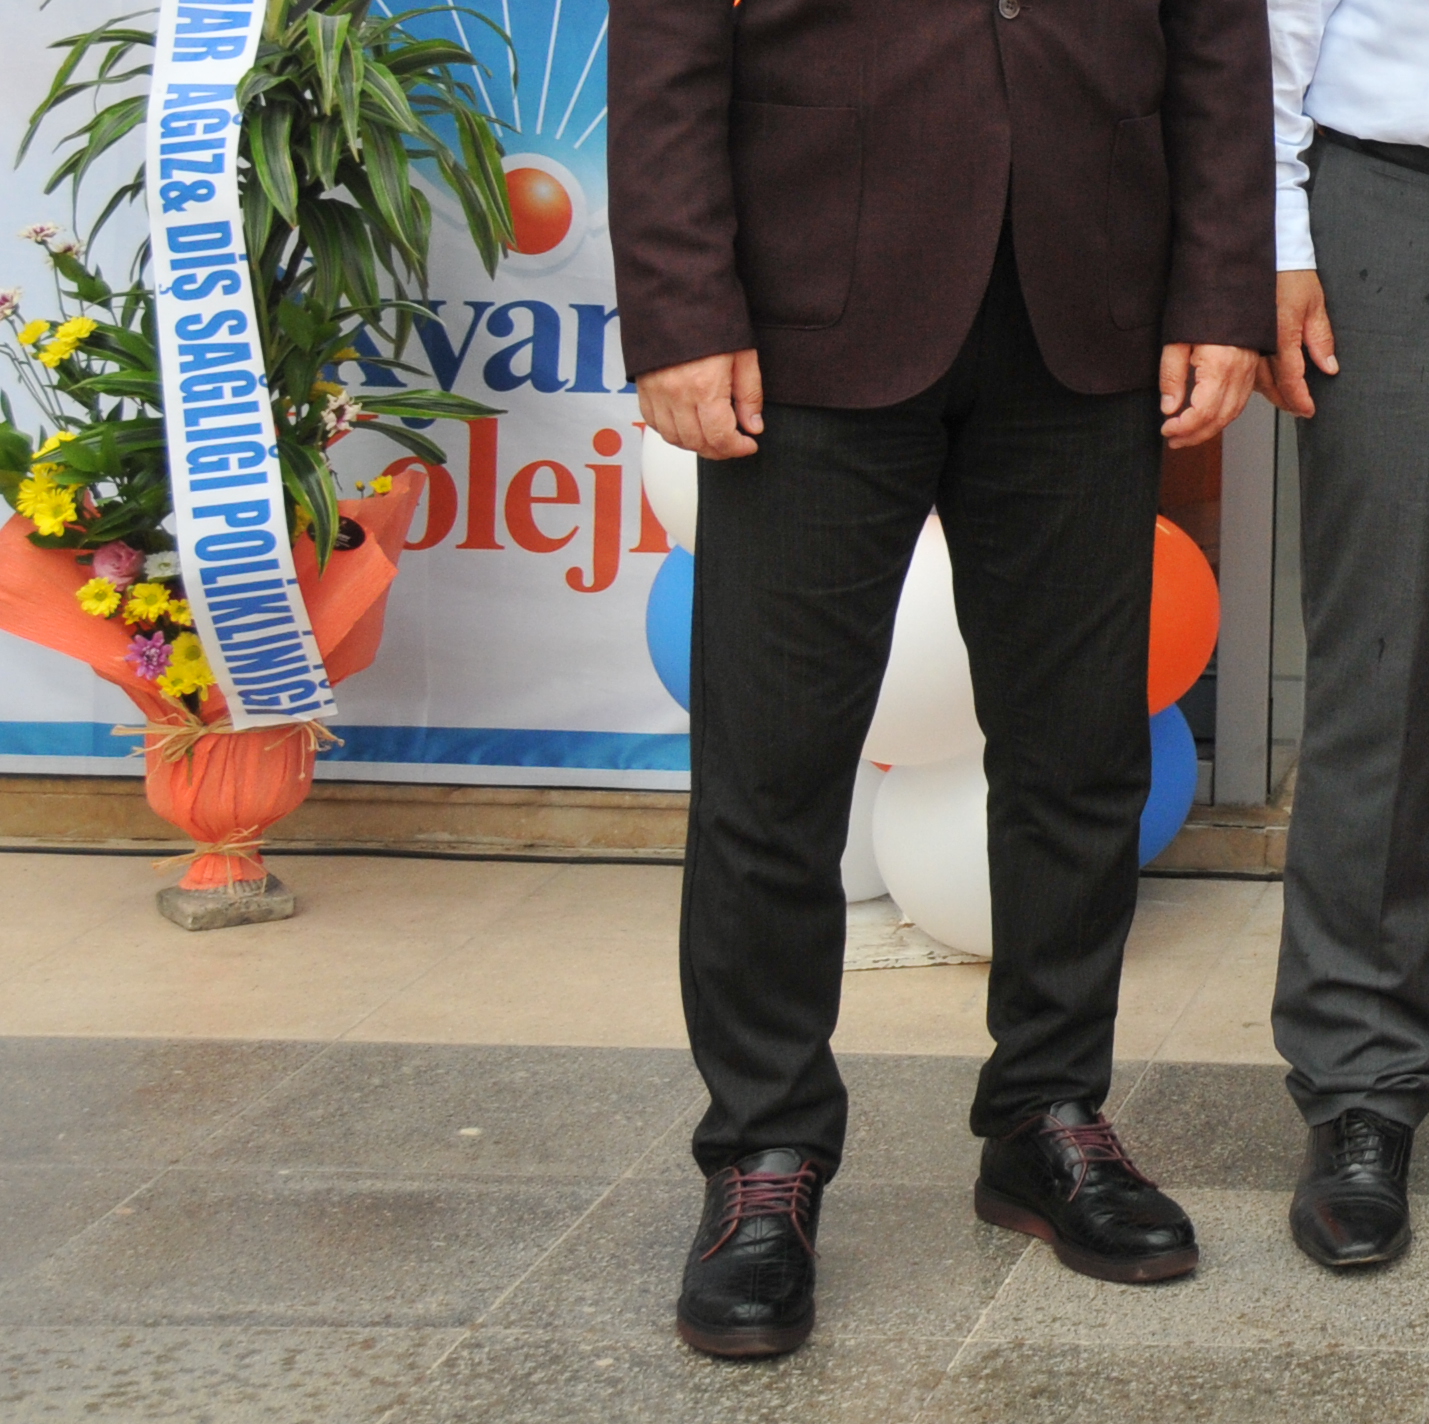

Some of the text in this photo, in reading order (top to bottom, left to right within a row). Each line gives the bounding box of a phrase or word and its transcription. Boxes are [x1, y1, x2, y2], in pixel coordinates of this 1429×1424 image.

[158, 220, 247, 302] DİŞ
[175, 309, 280, 493] SAĞLIĞI
[191, 498, 335, 716] POLİKLİNİĞİ
